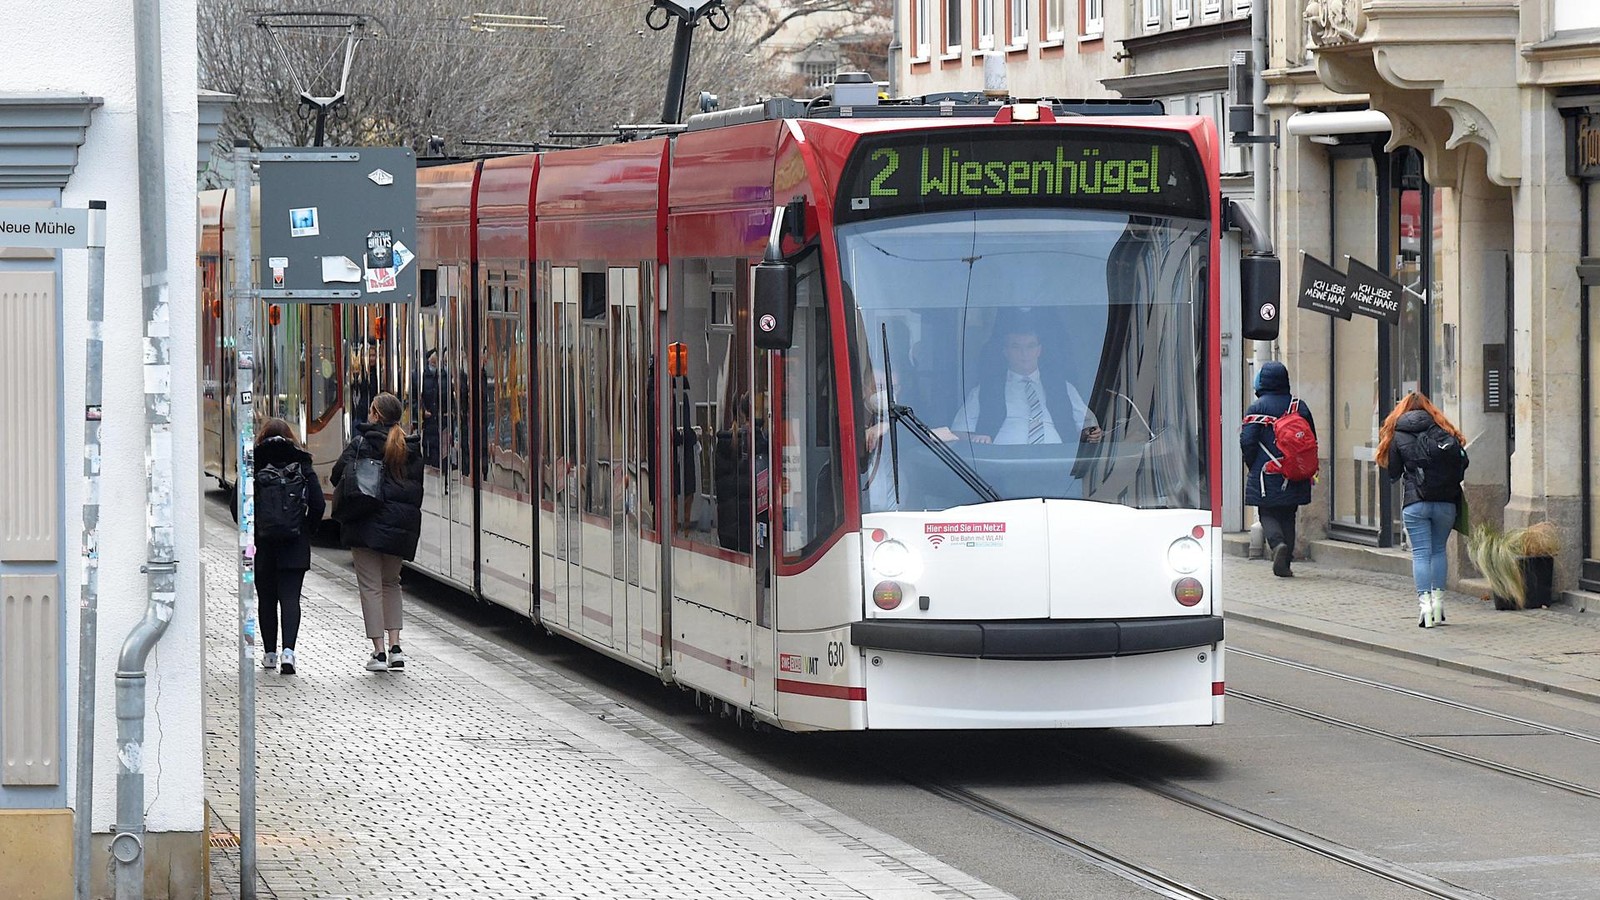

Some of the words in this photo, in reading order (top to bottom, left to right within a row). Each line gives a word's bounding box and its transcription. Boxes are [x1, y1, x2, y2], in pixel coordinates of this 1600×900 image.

[870, 147, 900, 196] 2
[920, 145, 1161, 197] Wiesenhügel
[35, 222, 76, 235] Mühle
[1304, 288, 1328, 301] MEINE
[1350, 291, 1374, 304] MEINE
[1373, 296, 1399, 311] HAARE
[926, 525, 942, 533] Hier
[943, 524, 959, 532] sind
[960, 523, 972, 532] Sie
[983, 523, 1003, 532] Netz!
[827, 641, 845, 667] 630
